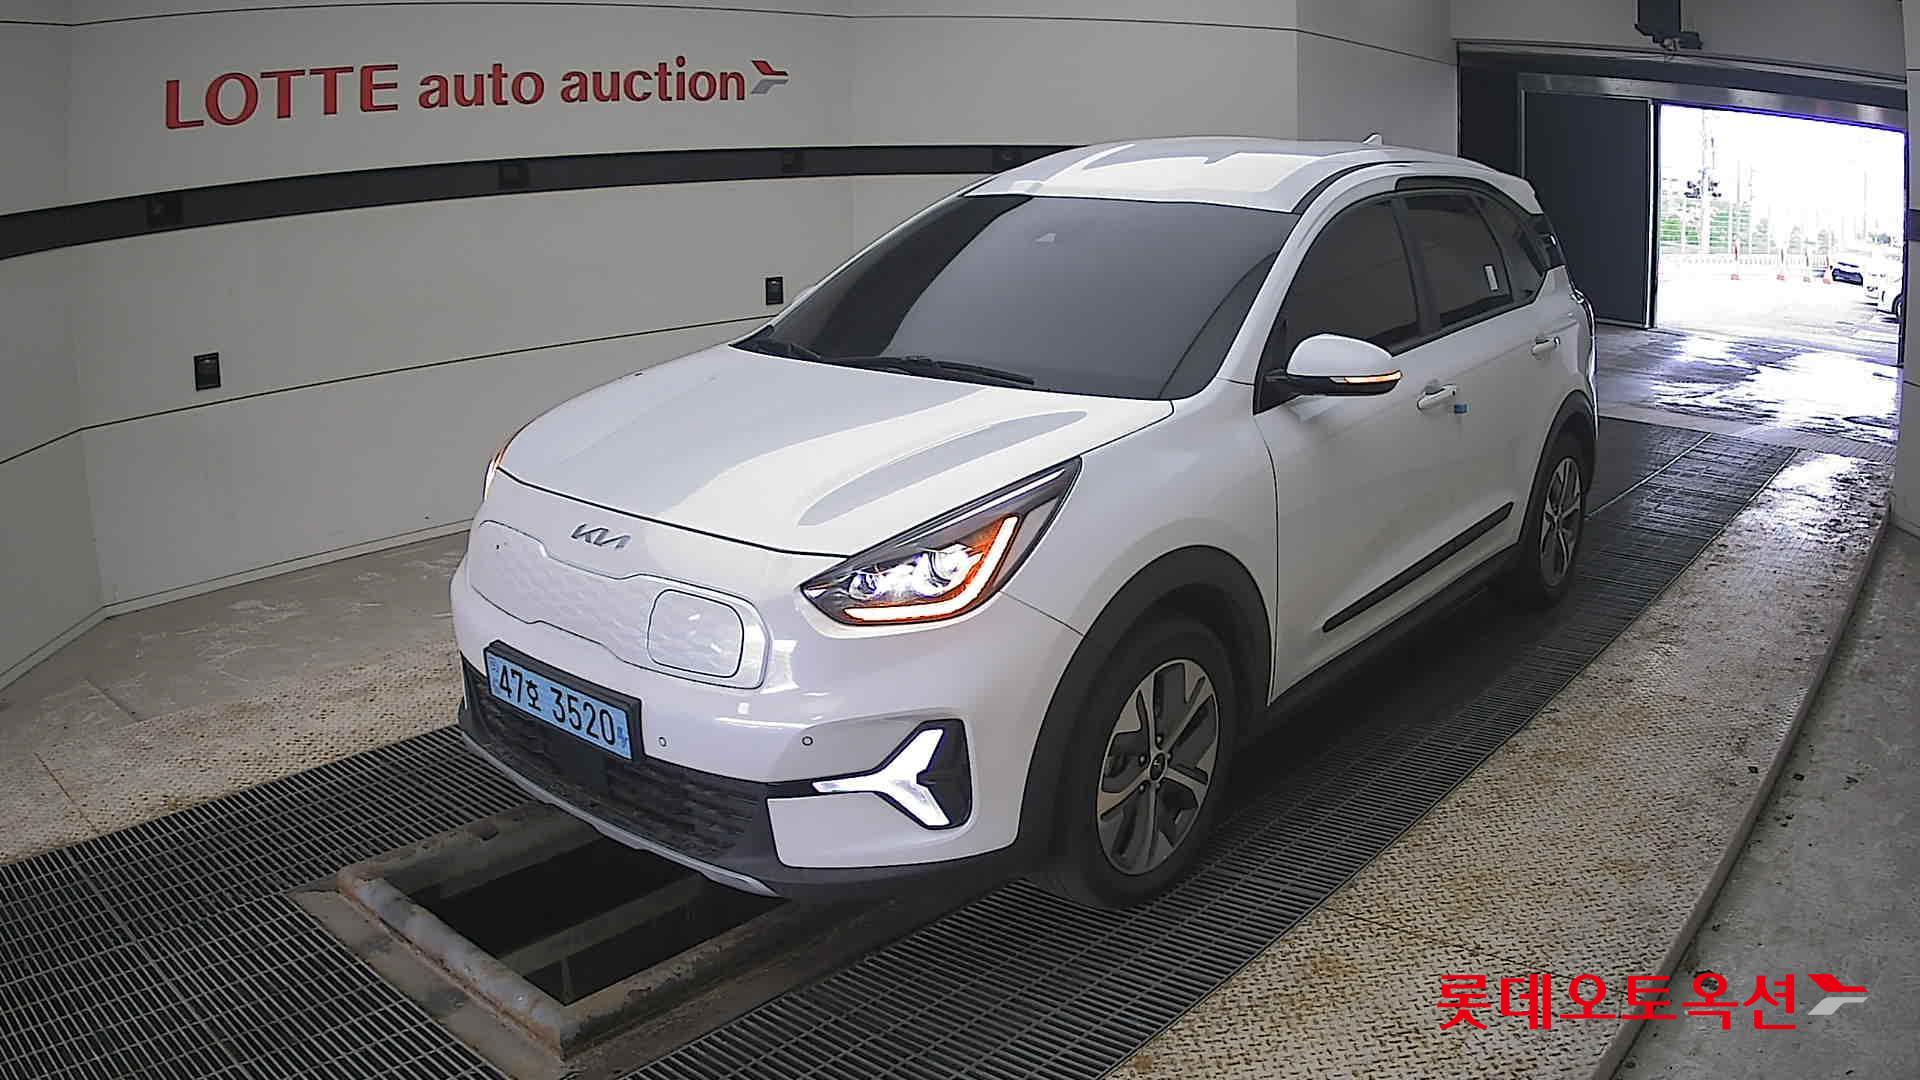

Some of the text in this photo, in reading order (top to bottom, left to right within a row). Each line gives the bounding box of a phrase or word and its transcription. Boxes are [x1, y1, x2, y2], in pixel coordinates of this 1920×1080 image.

[164, 55, 747, 129] LOTTE auto auction
[498, 664, 542, 711] 47호
[550, 686, 616, 746] 3520
